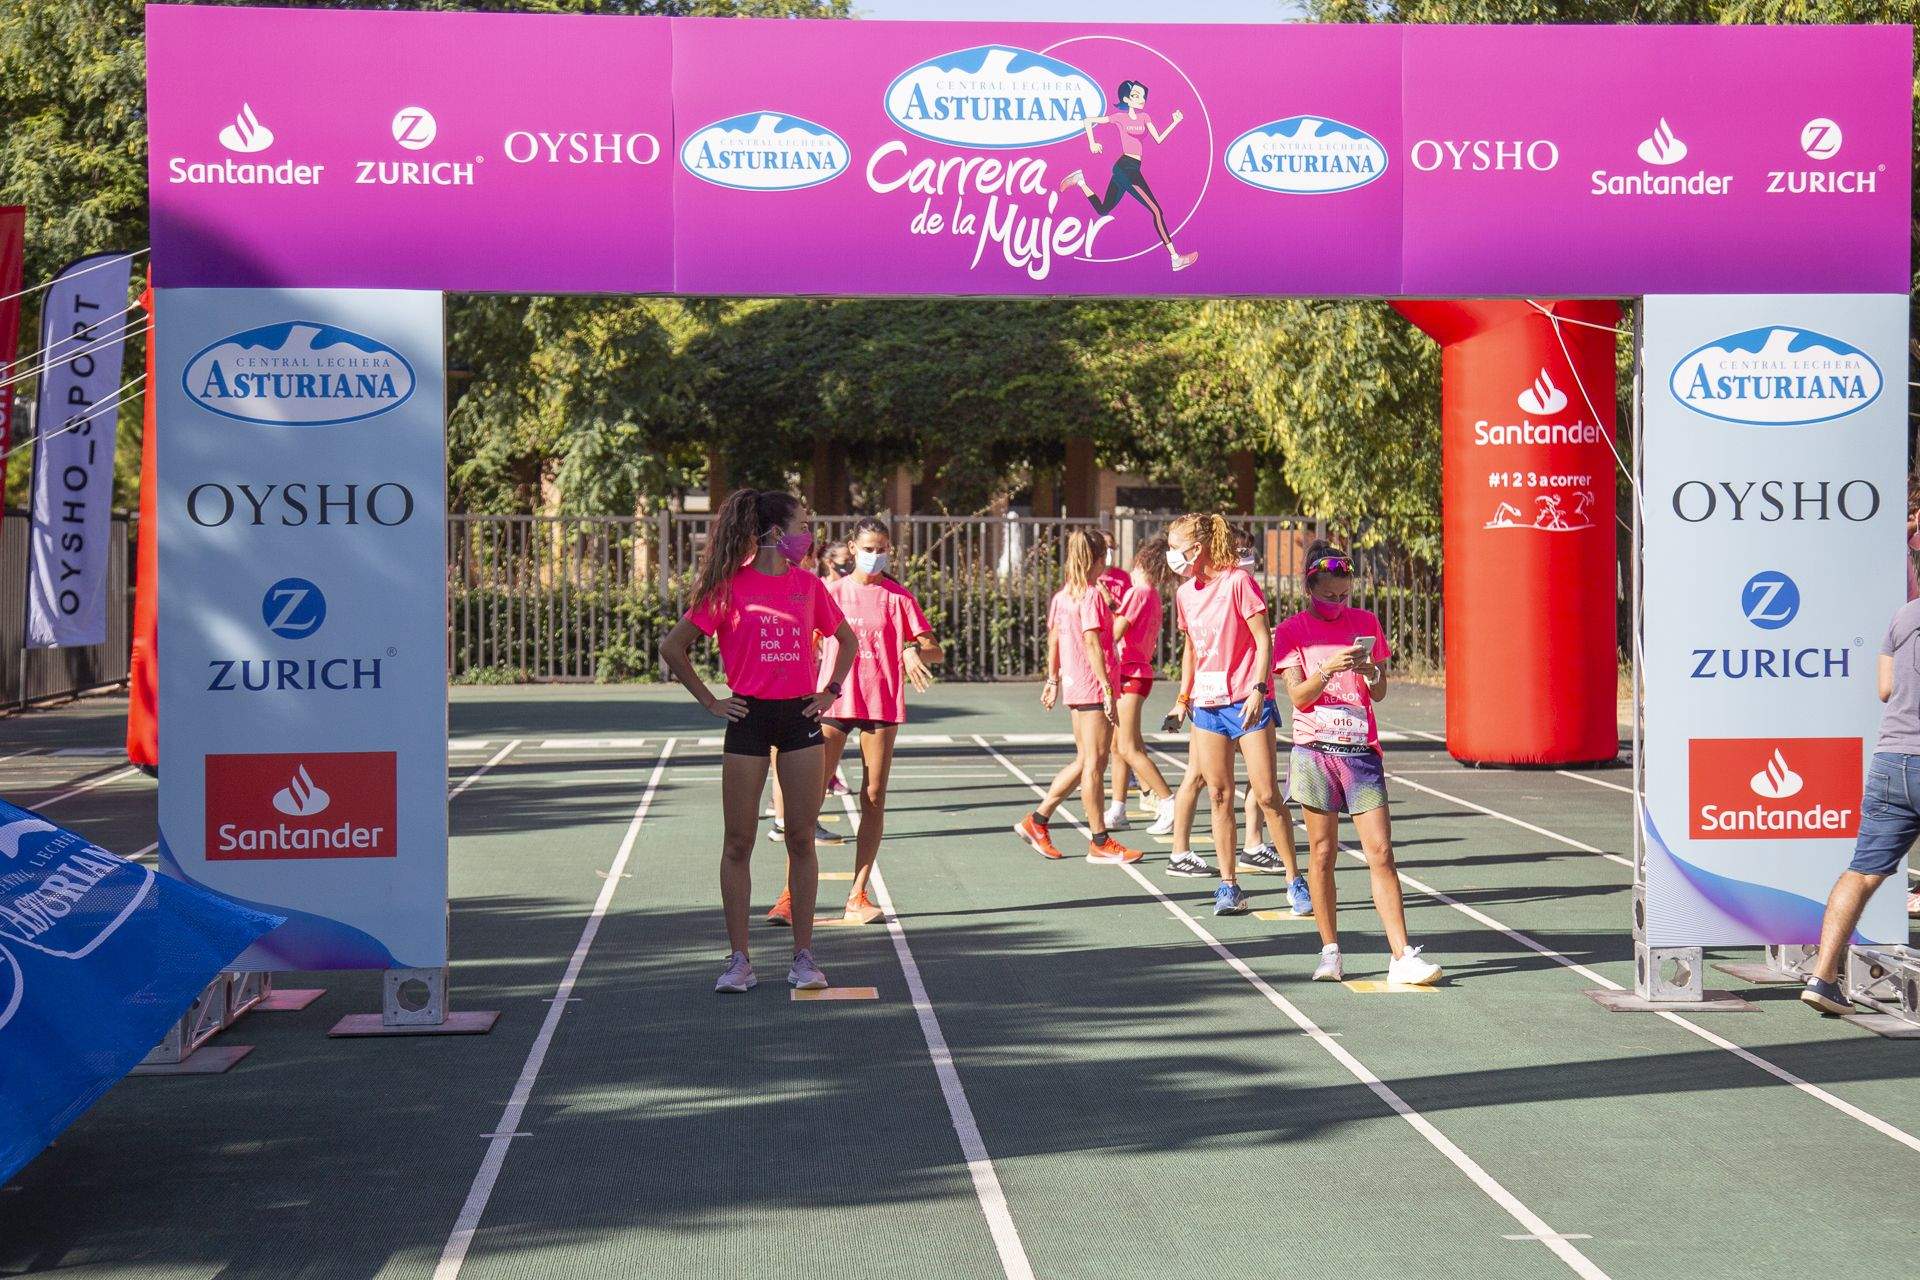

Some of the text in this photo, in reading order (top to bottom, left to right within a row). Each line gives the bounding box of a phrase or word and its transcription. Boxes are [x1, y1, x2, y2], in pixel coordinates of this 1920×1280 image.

[936, 81, 1081, 91] CENTRAL LECHERA
[902, 82, 1087, 121] ASTURIANA
[504, 131, 660, 165] OYSHO
[694, 140, 838, 170] ASTURIANA
[1238, 144, 1375, 174] ASTURIANA
[1411, 139, 1559, 172] OYSHO
[169, 157, 325, 186] Santander
[866, 140, 1048, 196] Carrera
[1591, 169, 1733, 197] Santander
[910, 191, 1116, 281] de la Mujer
[236, 357, 391, 368] CENTRAL LECHERA
[1719, 360, 1861, 370] CENTRAL LECHERA
[200, 360, 398, 399] ASTURIANA
[1686, 363, 1867, 400] ASTURIANA
[1474, 420, 1602, 446] Santander
[187, 483, 414, 527] OYSHO
[1672, 480, 1880, 523] OYSHO
[760, 615, 779, 624] WE
[761, 640, 801, 650] FOR A
[761, 652, 800, 662] REASON
[1333, 717, 1353, 727] 016
[1701, 804, 1852, 831] Santander
[218, 823, 384, 851] Santander
